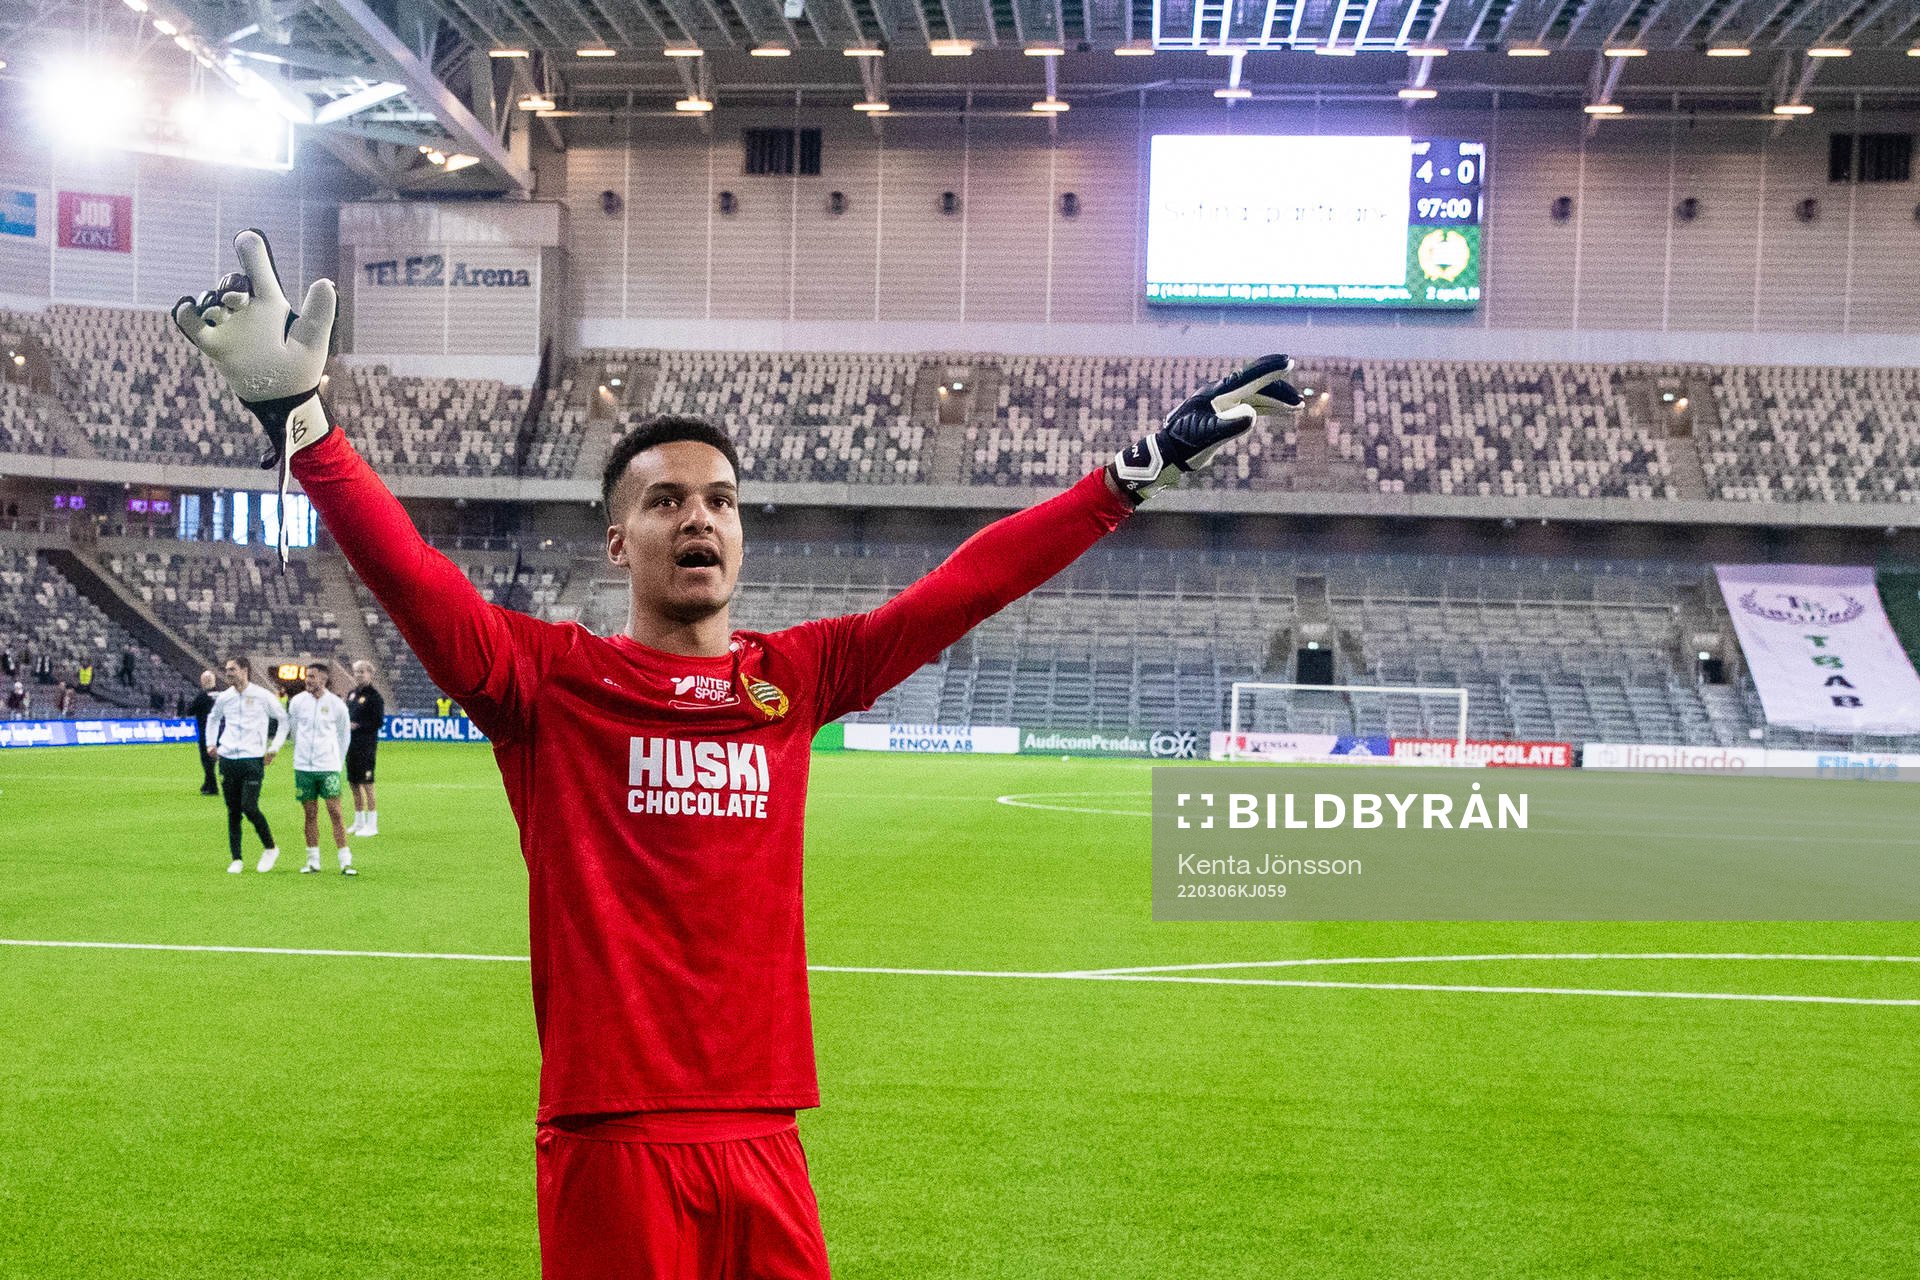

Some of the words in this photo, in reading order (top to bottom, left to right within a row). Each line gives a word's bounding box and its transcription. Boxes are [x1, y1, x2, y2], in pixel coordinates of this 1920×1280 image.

[1416, 160, 1433, 184] 4
[1457, 160, 1475, 184] 0
[1417, 198, 1472, 218] 97:00
[450, 262, 532, 287] Arena
[696, 676, 731, 691] INTER
[390, 718, 465, 740] CENTRAL
[889, 737, 949, 750] RENOVA
[954, 739, 973, 751] AB
[628, 736, 770, 792] HUSKI
[1627, 747, 1746, 771] limitado
[627, 789, 769, 819] CHOCOLATE
